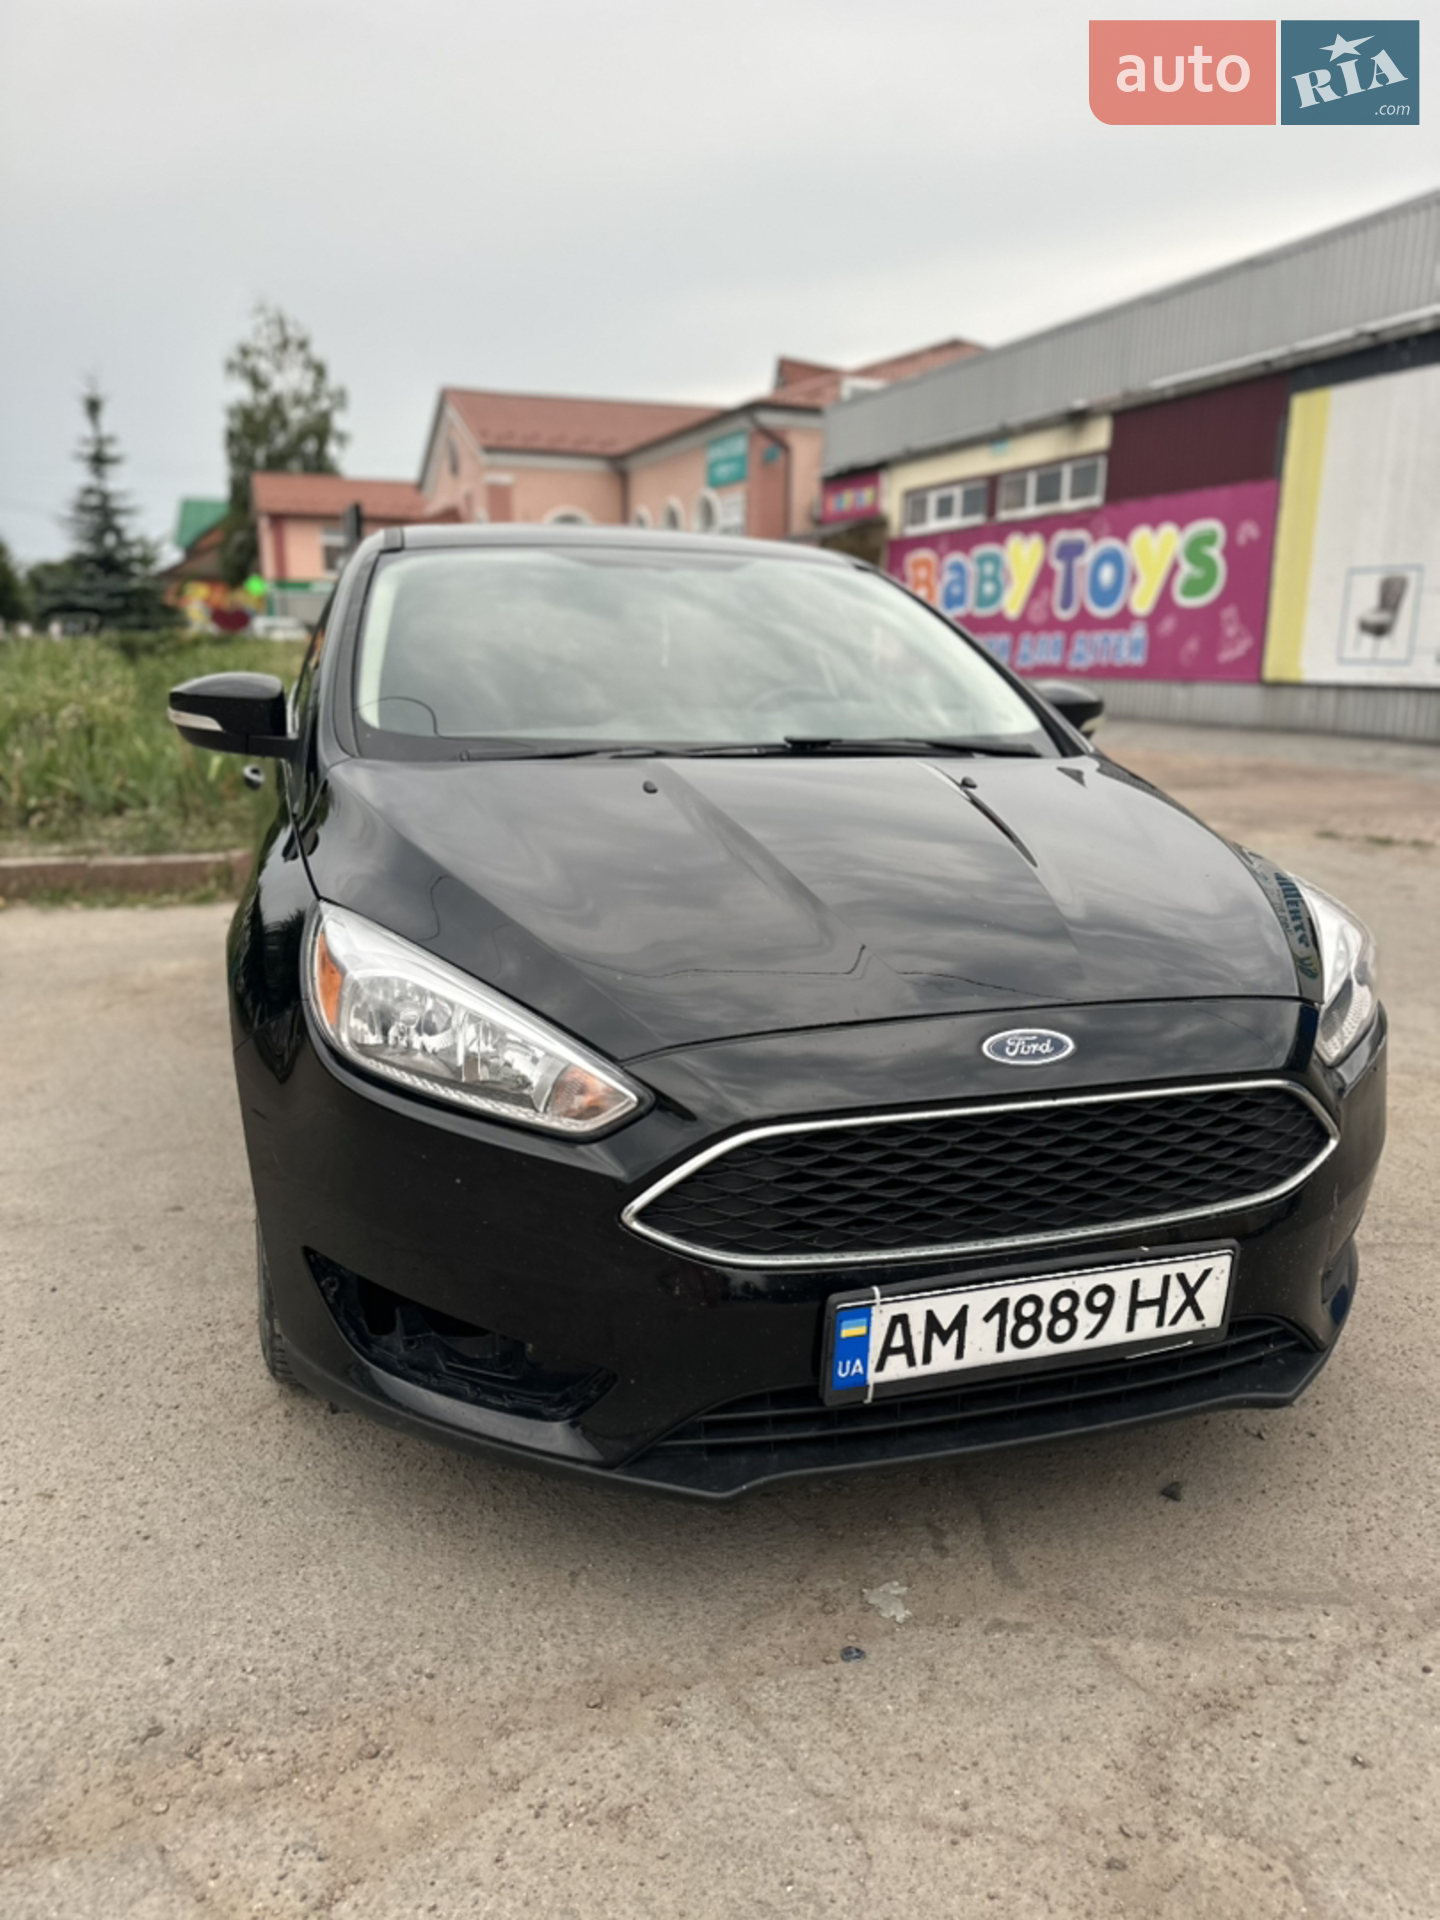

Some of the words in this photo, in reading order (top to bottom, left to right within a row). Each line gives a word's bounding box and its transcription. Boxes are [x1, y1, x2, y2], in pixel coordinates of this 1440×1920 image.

[1004, 1034, 1055, 1057] Ford
[874, 1303, 970, 1373] AM
[982, 1283, 1116, 1354] 1889
[1125, 1266, 1214, 1334] HX
[837, 1357, 865, 1378] UA
